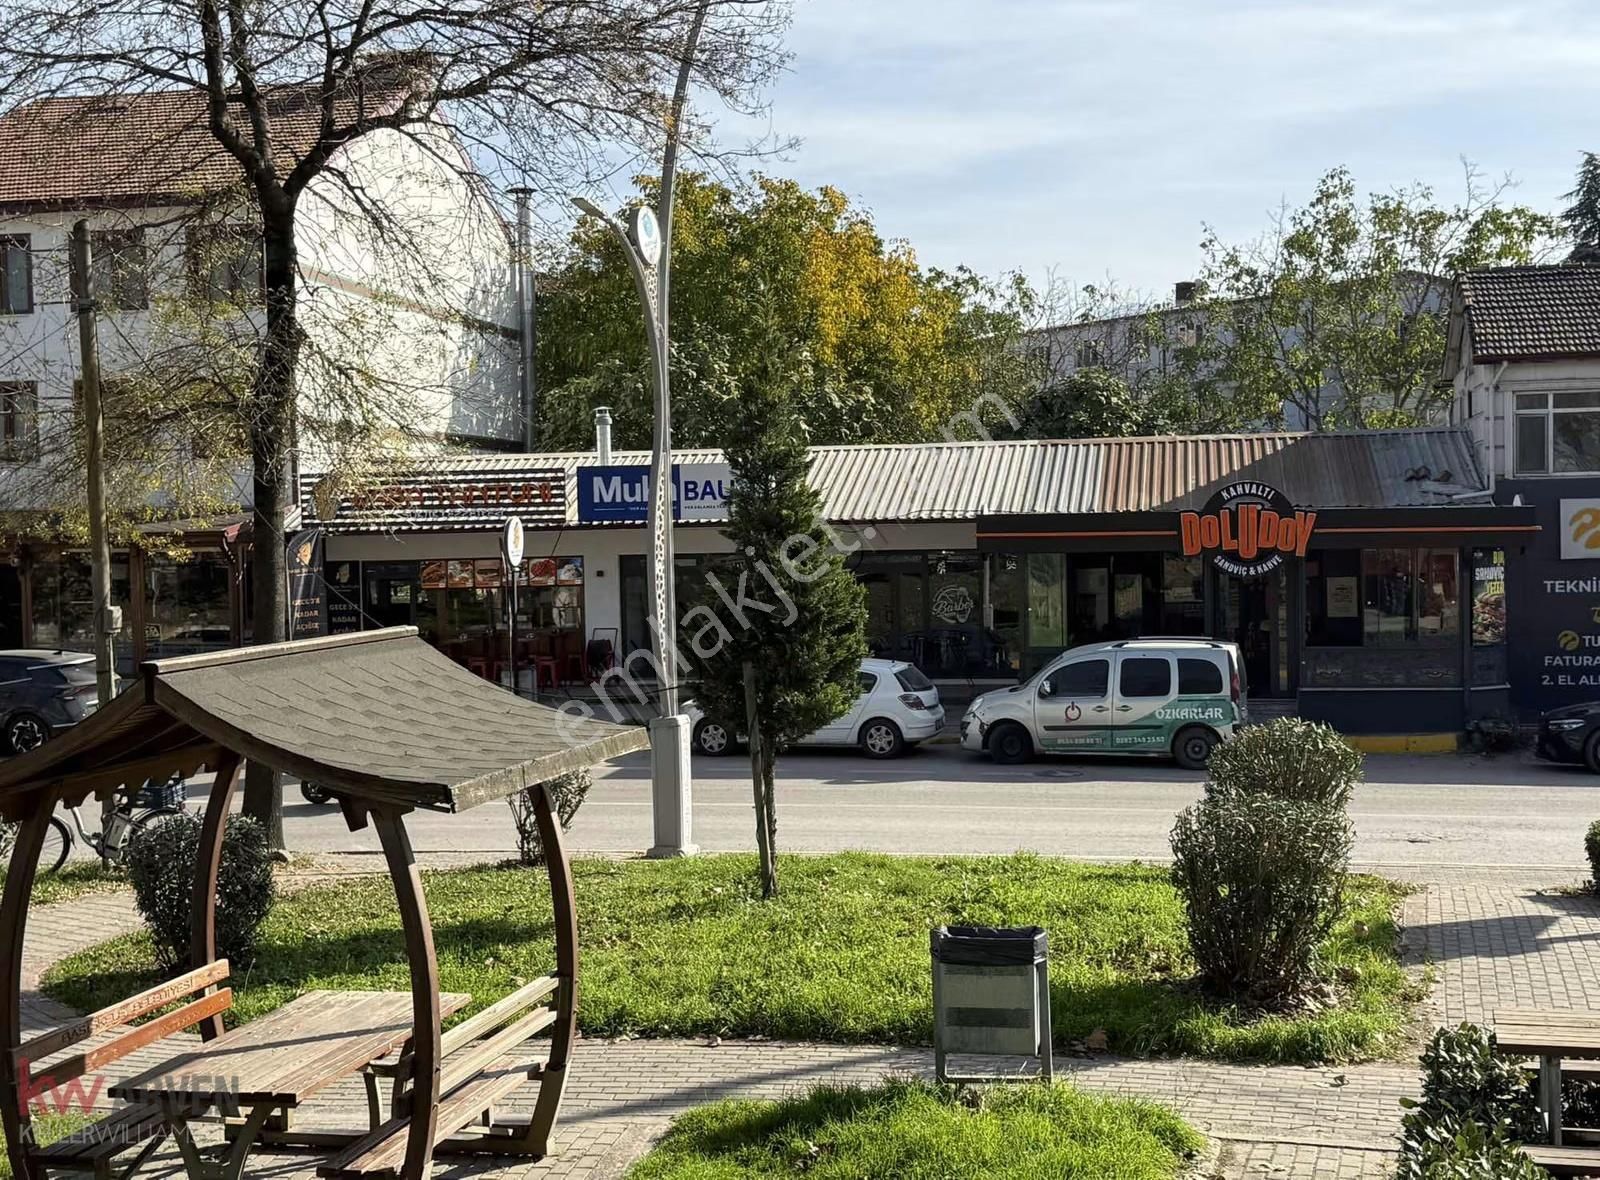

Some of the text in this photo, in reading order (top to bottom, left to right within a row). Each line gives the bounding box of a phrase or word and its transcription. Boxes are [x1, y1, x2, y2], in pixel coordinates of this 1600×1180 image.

[1221, 483, 1275, 500] KAHVALTI
[1214, 554, 1283, 576] SANDVİÇ & KAHVE
[1541, 674, 1554, 686] 2.
[1558, 674, 1576, 686] EL
